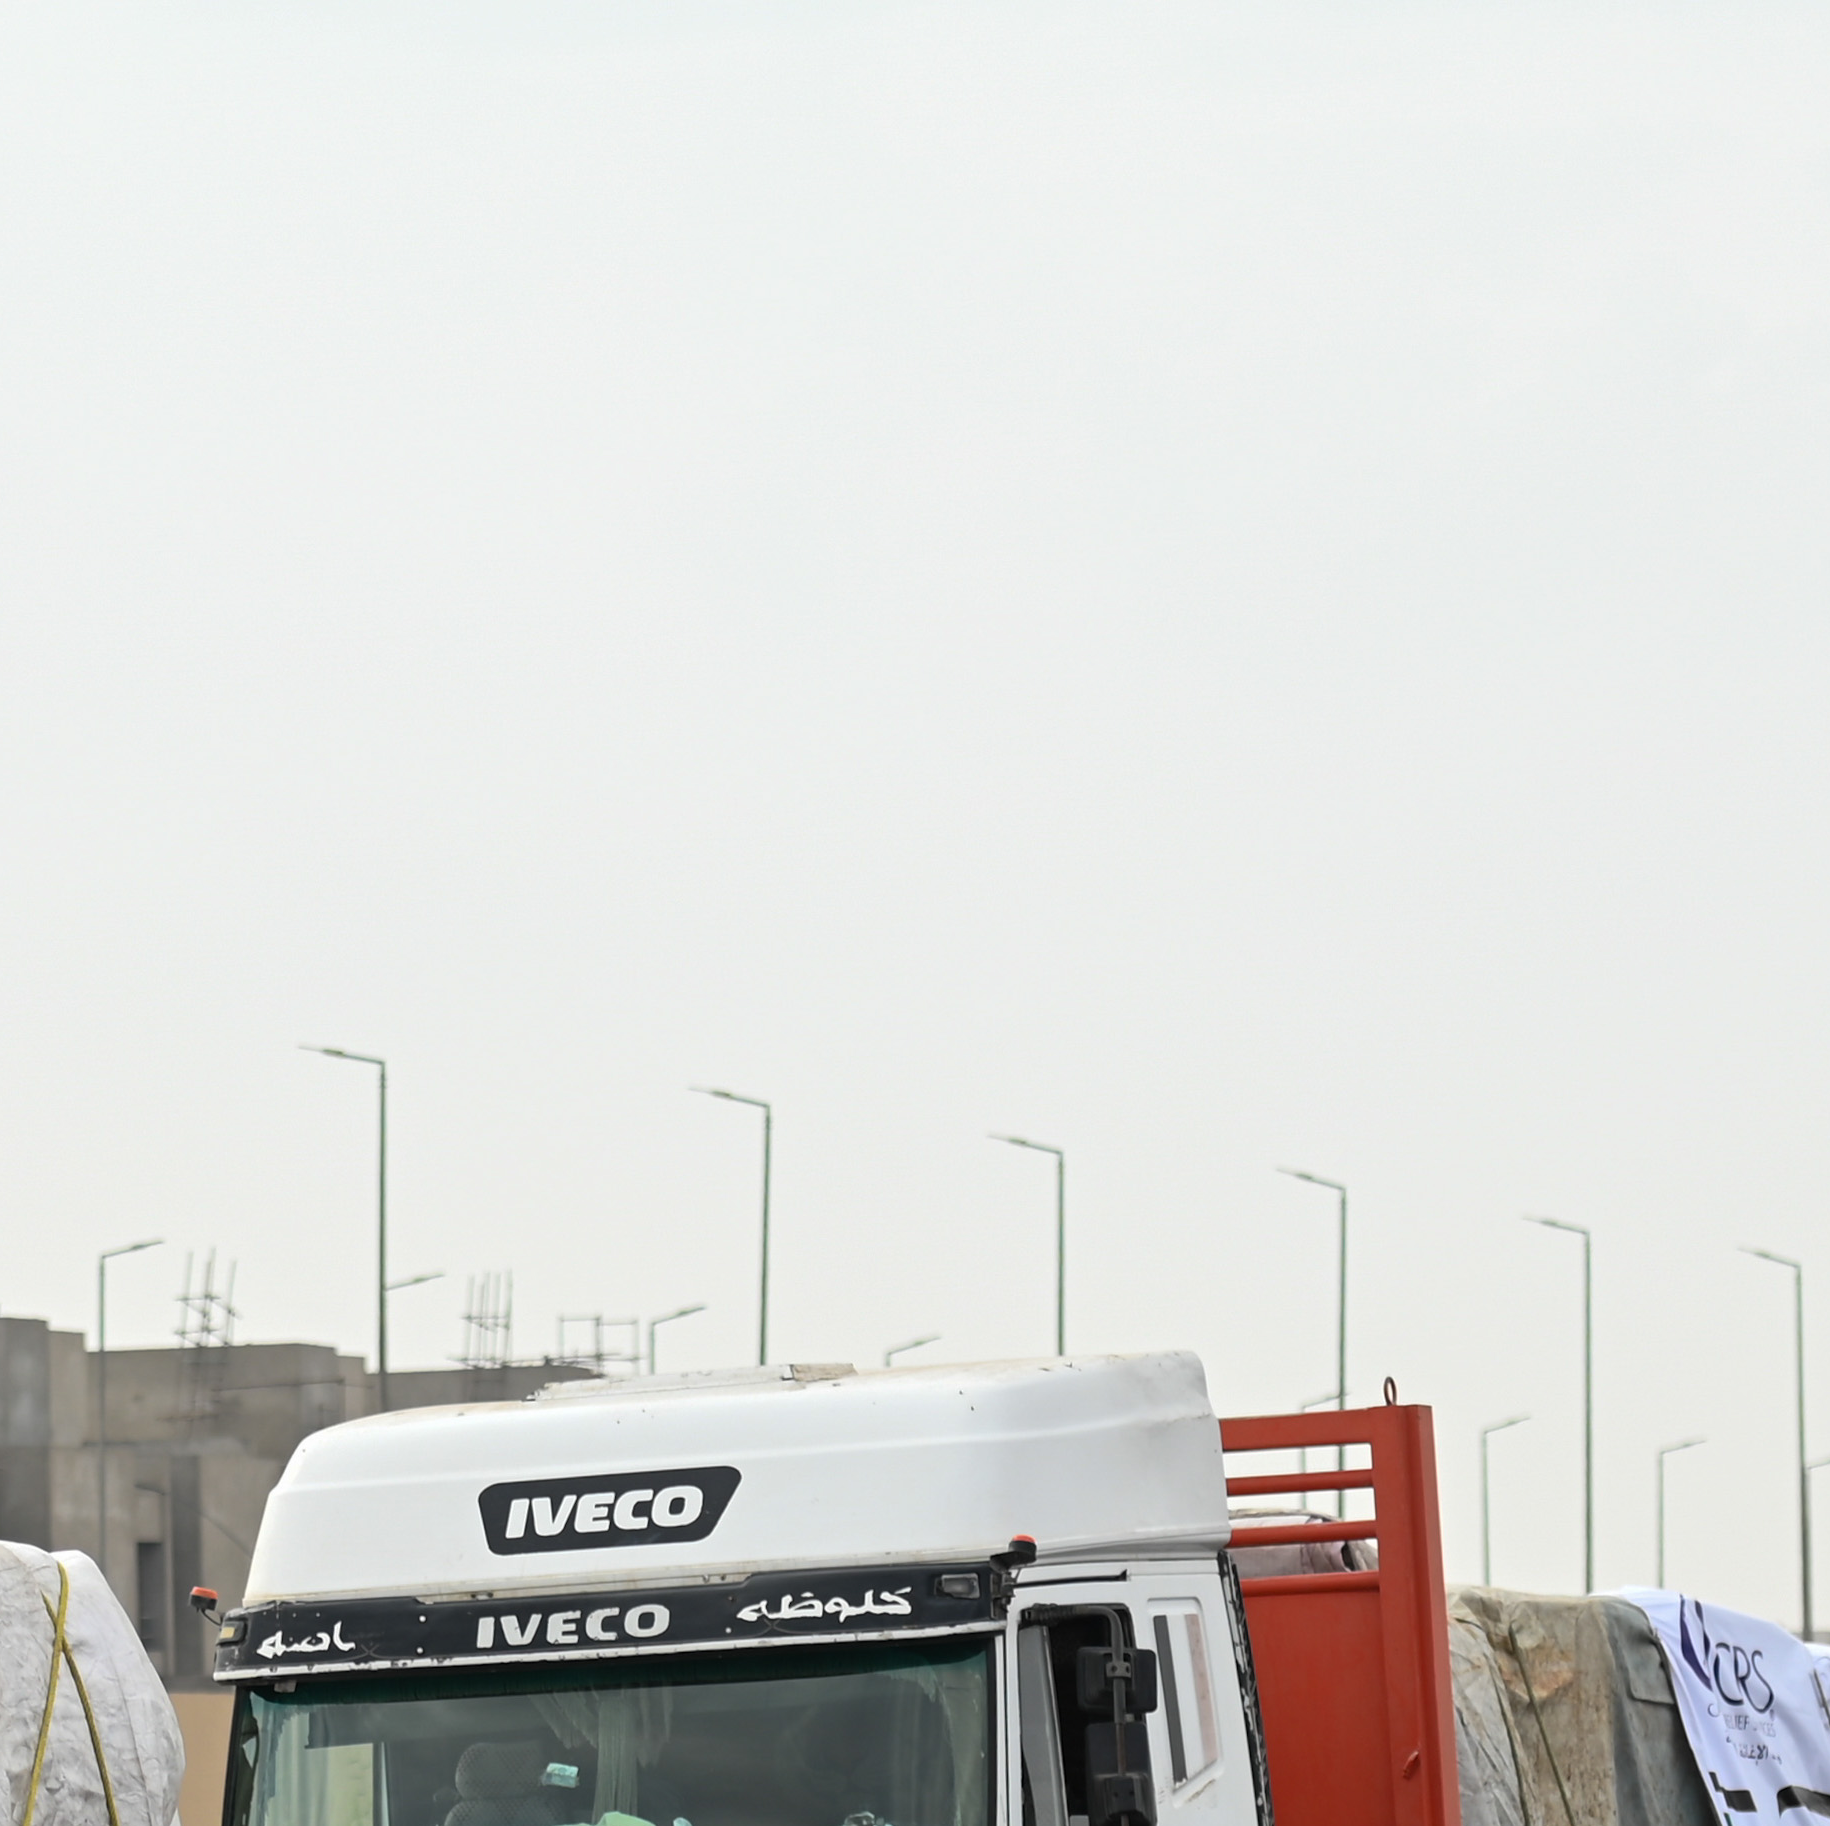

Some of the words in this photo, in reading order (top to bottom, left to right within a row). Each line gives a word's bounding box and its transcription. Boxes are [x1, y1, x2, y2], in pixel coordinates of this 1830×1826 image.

[505, 1485, 704, 1540] IVECO
[475, 1602, 671, 1649] IVECO
[1713, 1642, 1775, 1714] CRS
